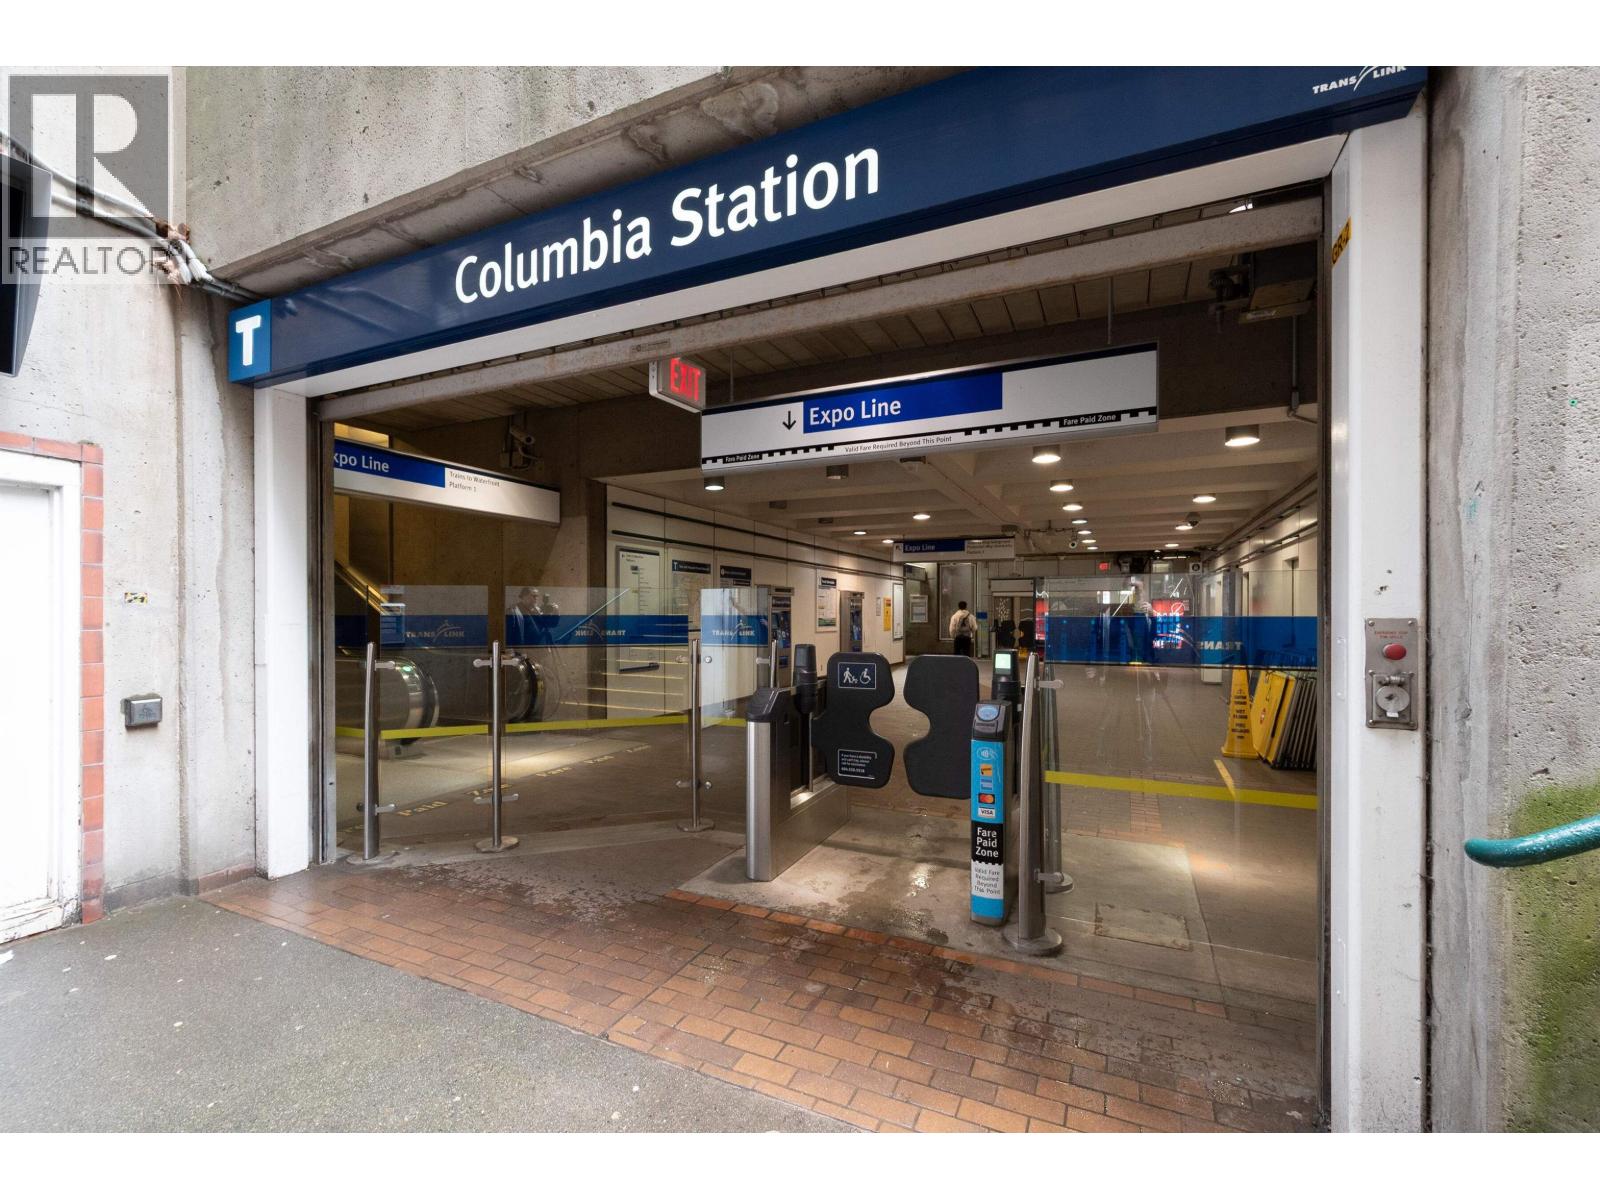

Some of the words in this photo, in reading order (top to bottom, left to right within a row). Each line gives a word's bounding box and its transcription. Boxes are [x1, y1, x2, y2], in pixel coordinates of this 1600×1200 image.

[1312, 76, 1357, 94] TRANS
[455, 208, 652, 304] Columbia
[669, 147, 880, 248] Station
[235, 314, 262, 367] T
[670, 357, 701, 402] EXIT
[810, 407, 855, 428] Expo
[861, 398, 901, 419] Line
[1063, 418, 1079, 426] Fare
[1080, 416, 1096, 424] Paid
[1097, 414, 1117, 422] Zone
[872, 442, 898, 450] Required
[899, 440, 921, 448] Beyond
[362, 455, 390, 473] Line
[449, 471, 466, 480] Trains
[449, 481, 473, 490] Platform
[905, 544, 921, 552] Expo
[977, 826, 997, 838] Fare
[976, 837, 998, 848] Paid
[975, 846, 999, 858] Zone
